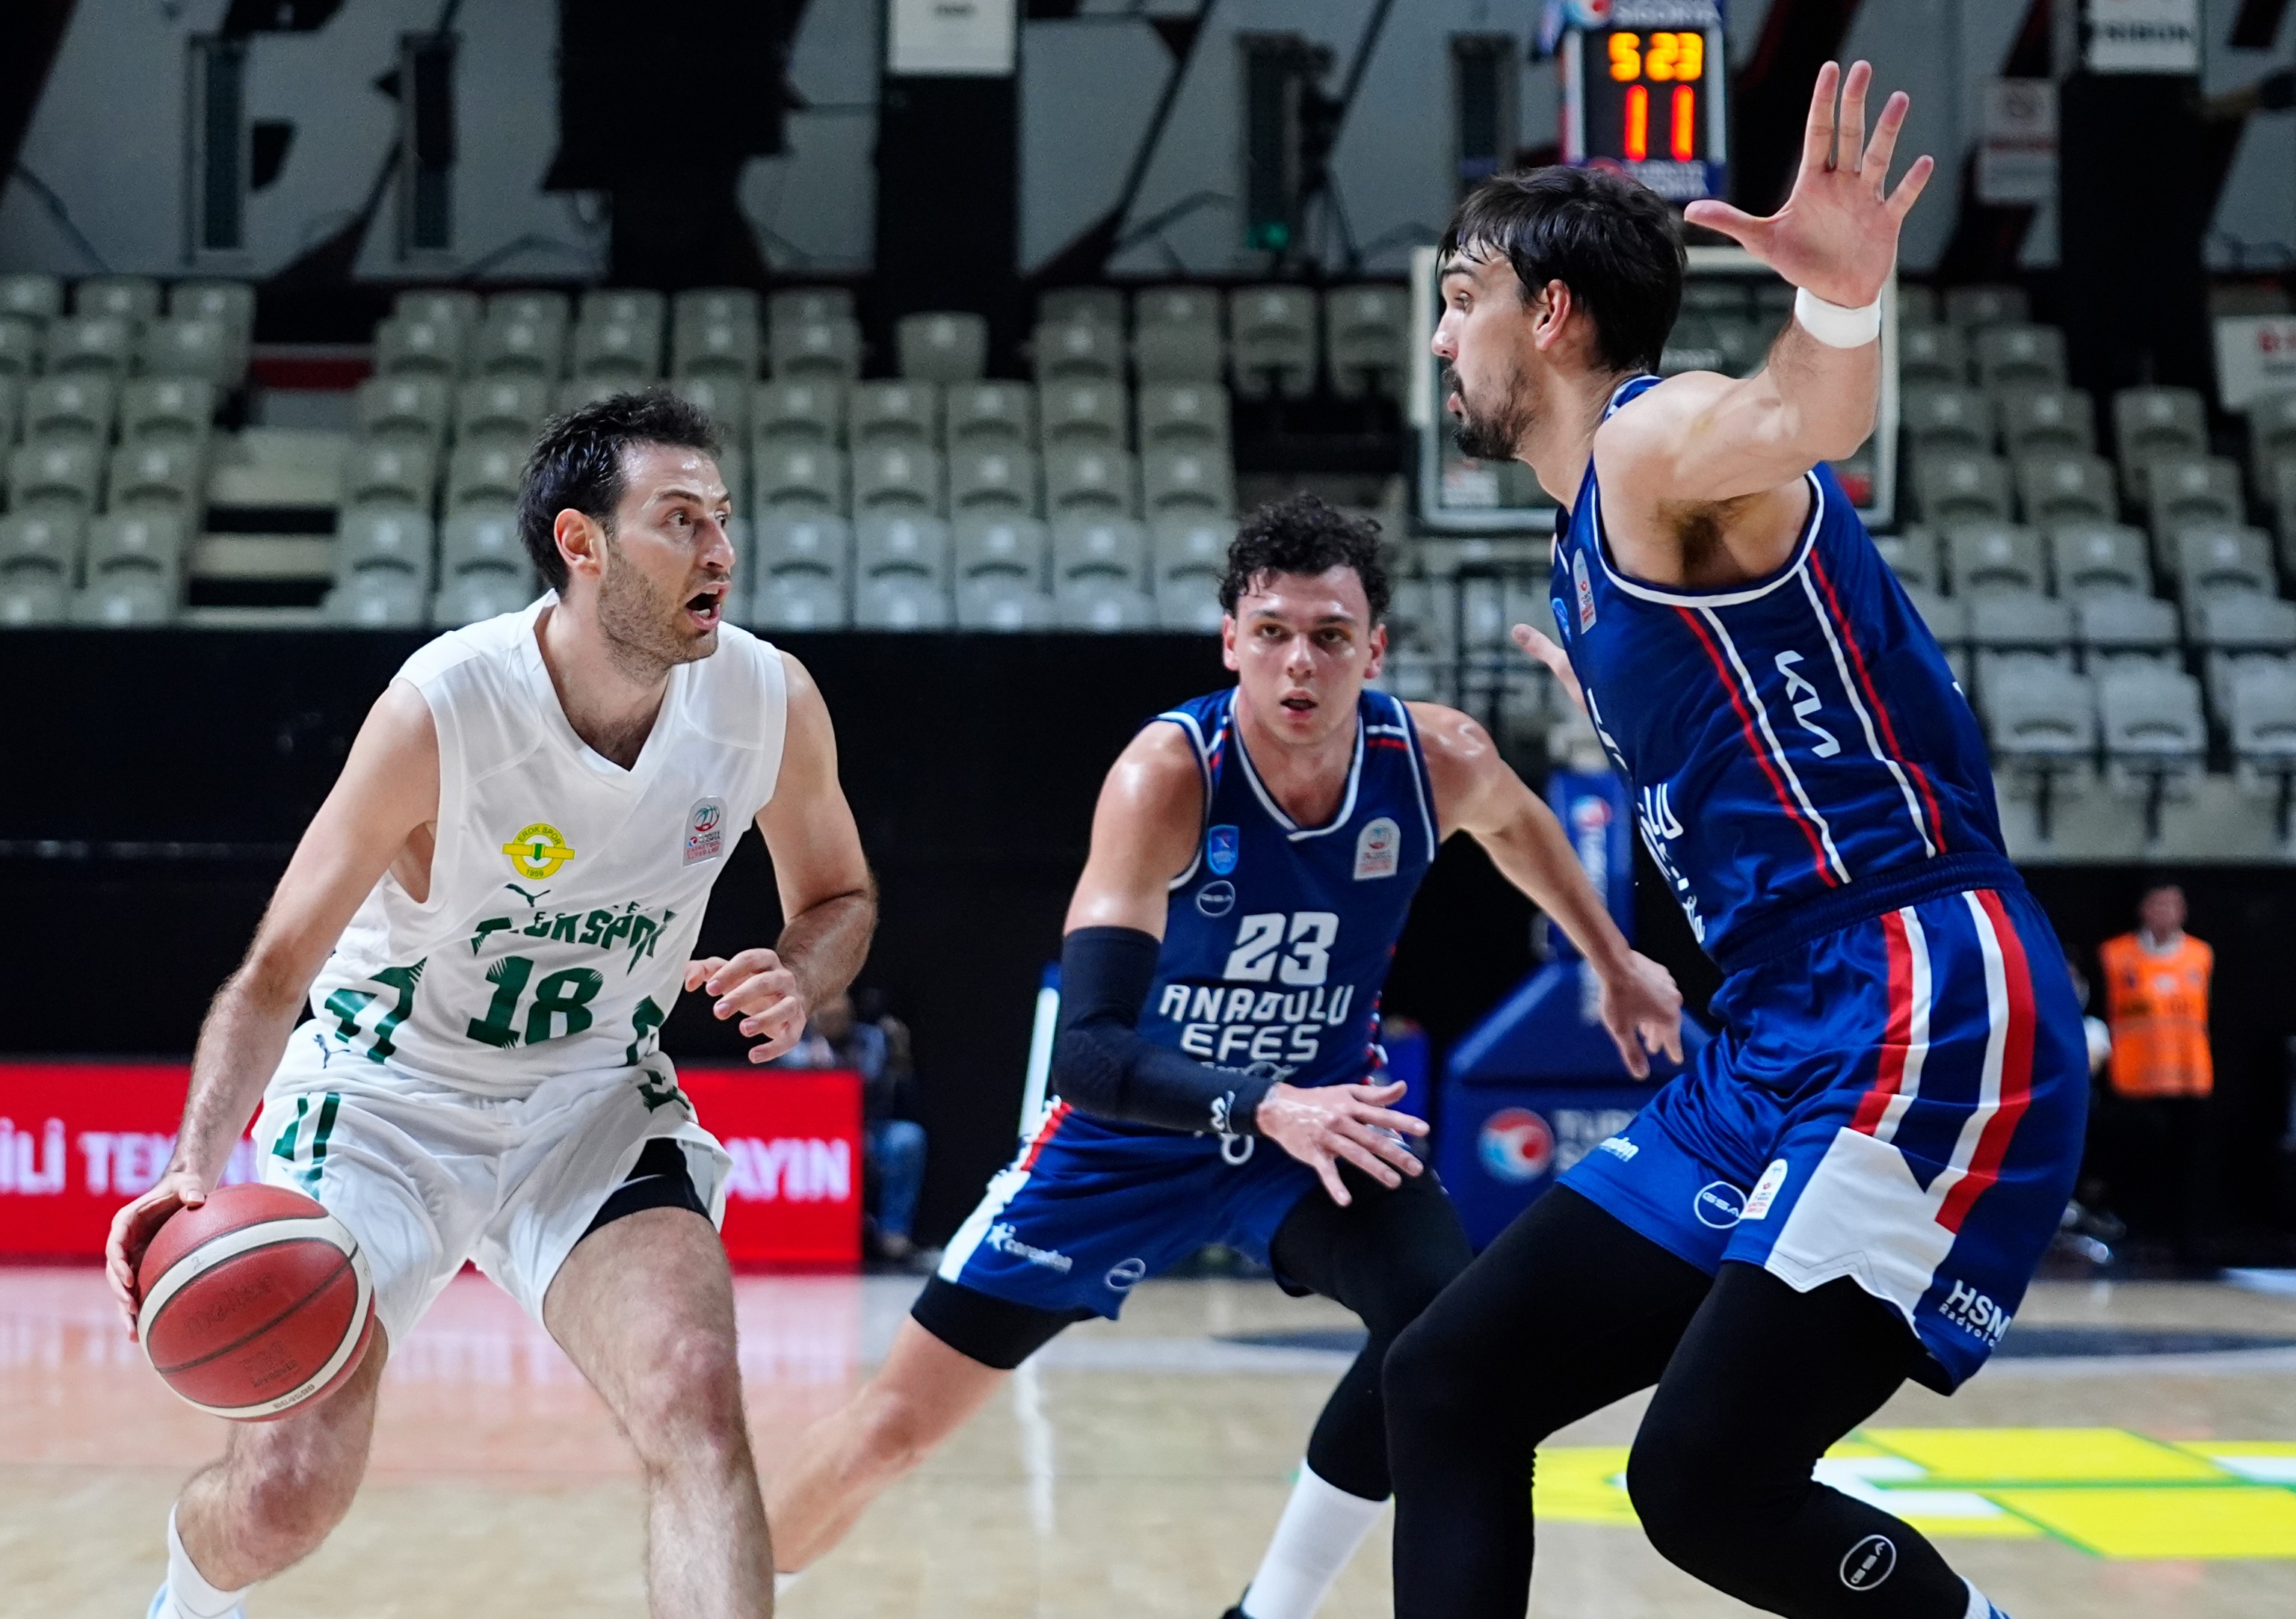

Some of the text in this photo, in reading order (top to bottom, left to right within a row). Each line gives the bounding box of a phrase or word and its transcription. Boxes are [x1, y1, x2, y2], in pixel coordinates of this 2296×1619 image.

[1608, 31, 1641, 81] 5
[1624, 84, 1694, 163] 11
[517, 825, 562, 846] EROK SPOR
[525, 869, 544, 878] 1959
[1223, 911, 1339, 987] 23
[466, 955, 604, 1049] 18
[1179, 1023, 1323, 1063] EFES
[1702, 1191, 1740, 1218] GSA
[1945, 1279, 2012, 1342] HSM
